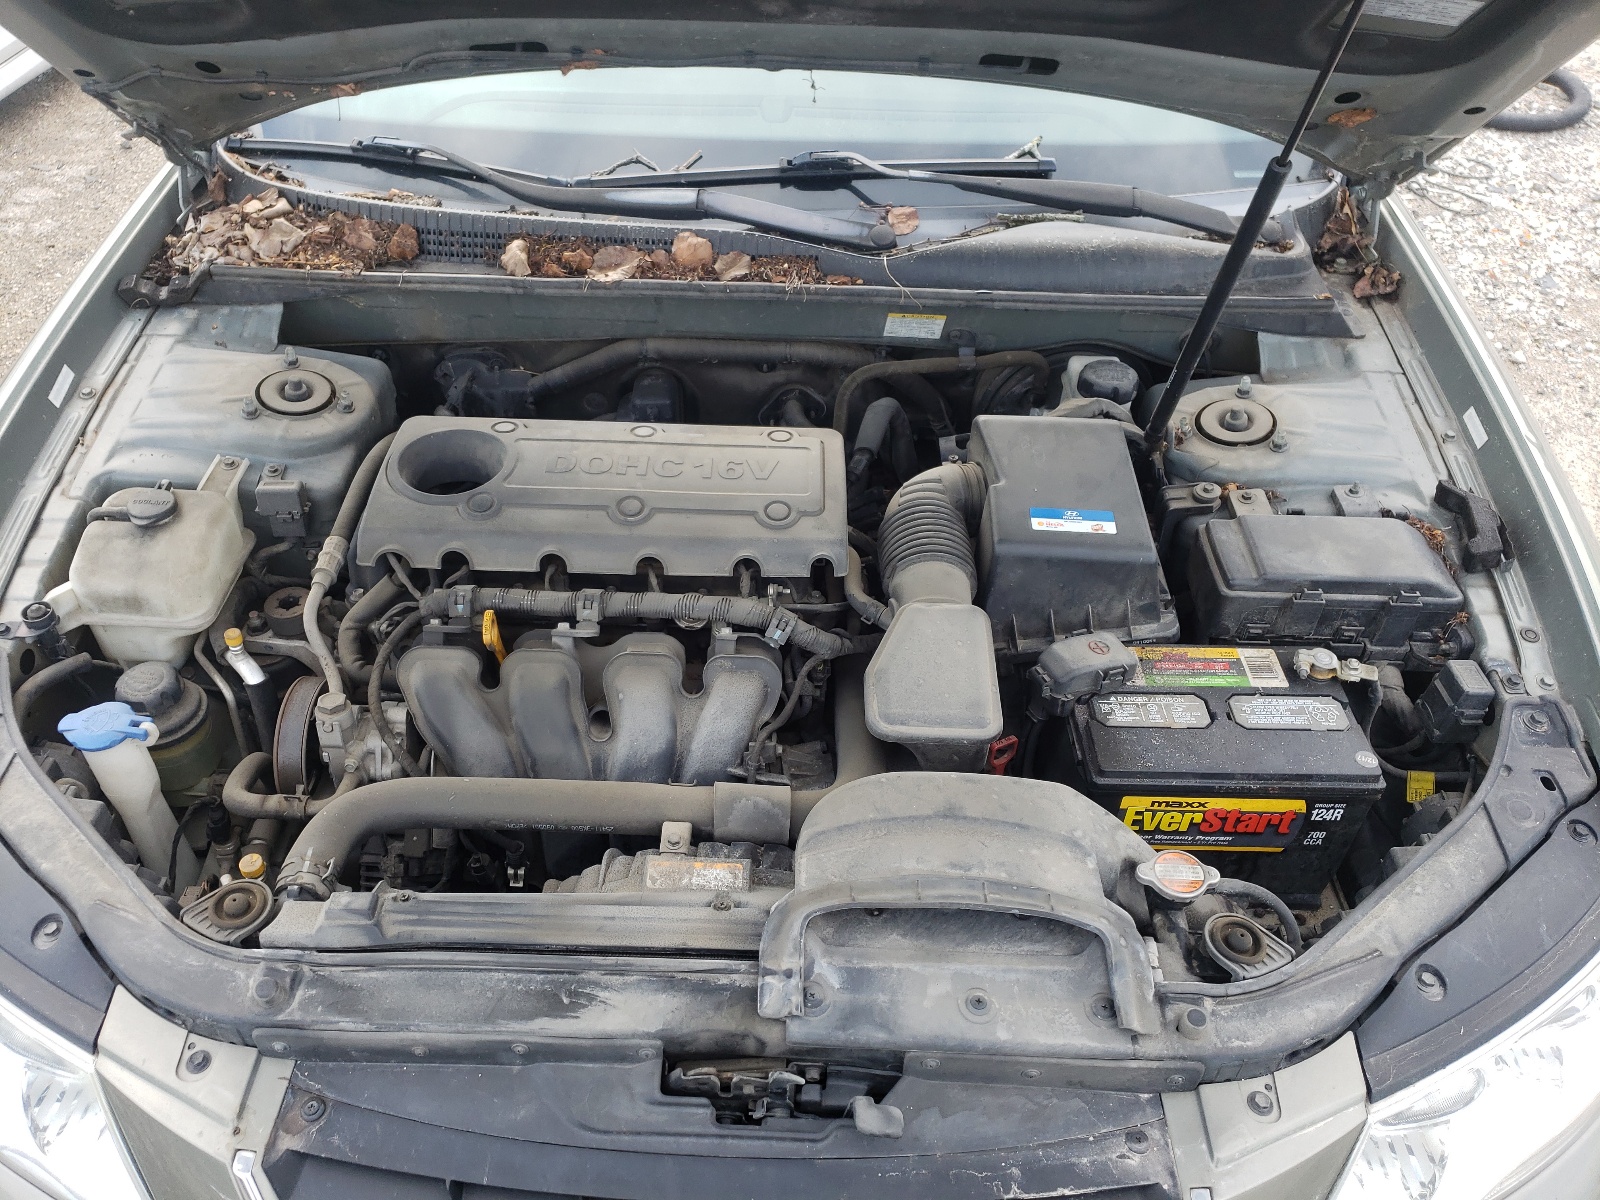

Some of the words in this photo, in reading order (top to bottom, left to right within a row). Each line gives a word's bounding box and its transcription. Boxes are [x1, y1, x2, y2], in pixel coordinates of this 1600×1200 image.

[545, 455, 684, 478] DOHC
[694, 457, 780, 480] 16V
[1150, 800, 1210, 808] maxx
[1124, 806, 1297, 833] EverStart
[1310, 808, 1345, 821] 124R
[1195, 834, 1234, 842] Program
[1307, 831, 1327, 839] 700
